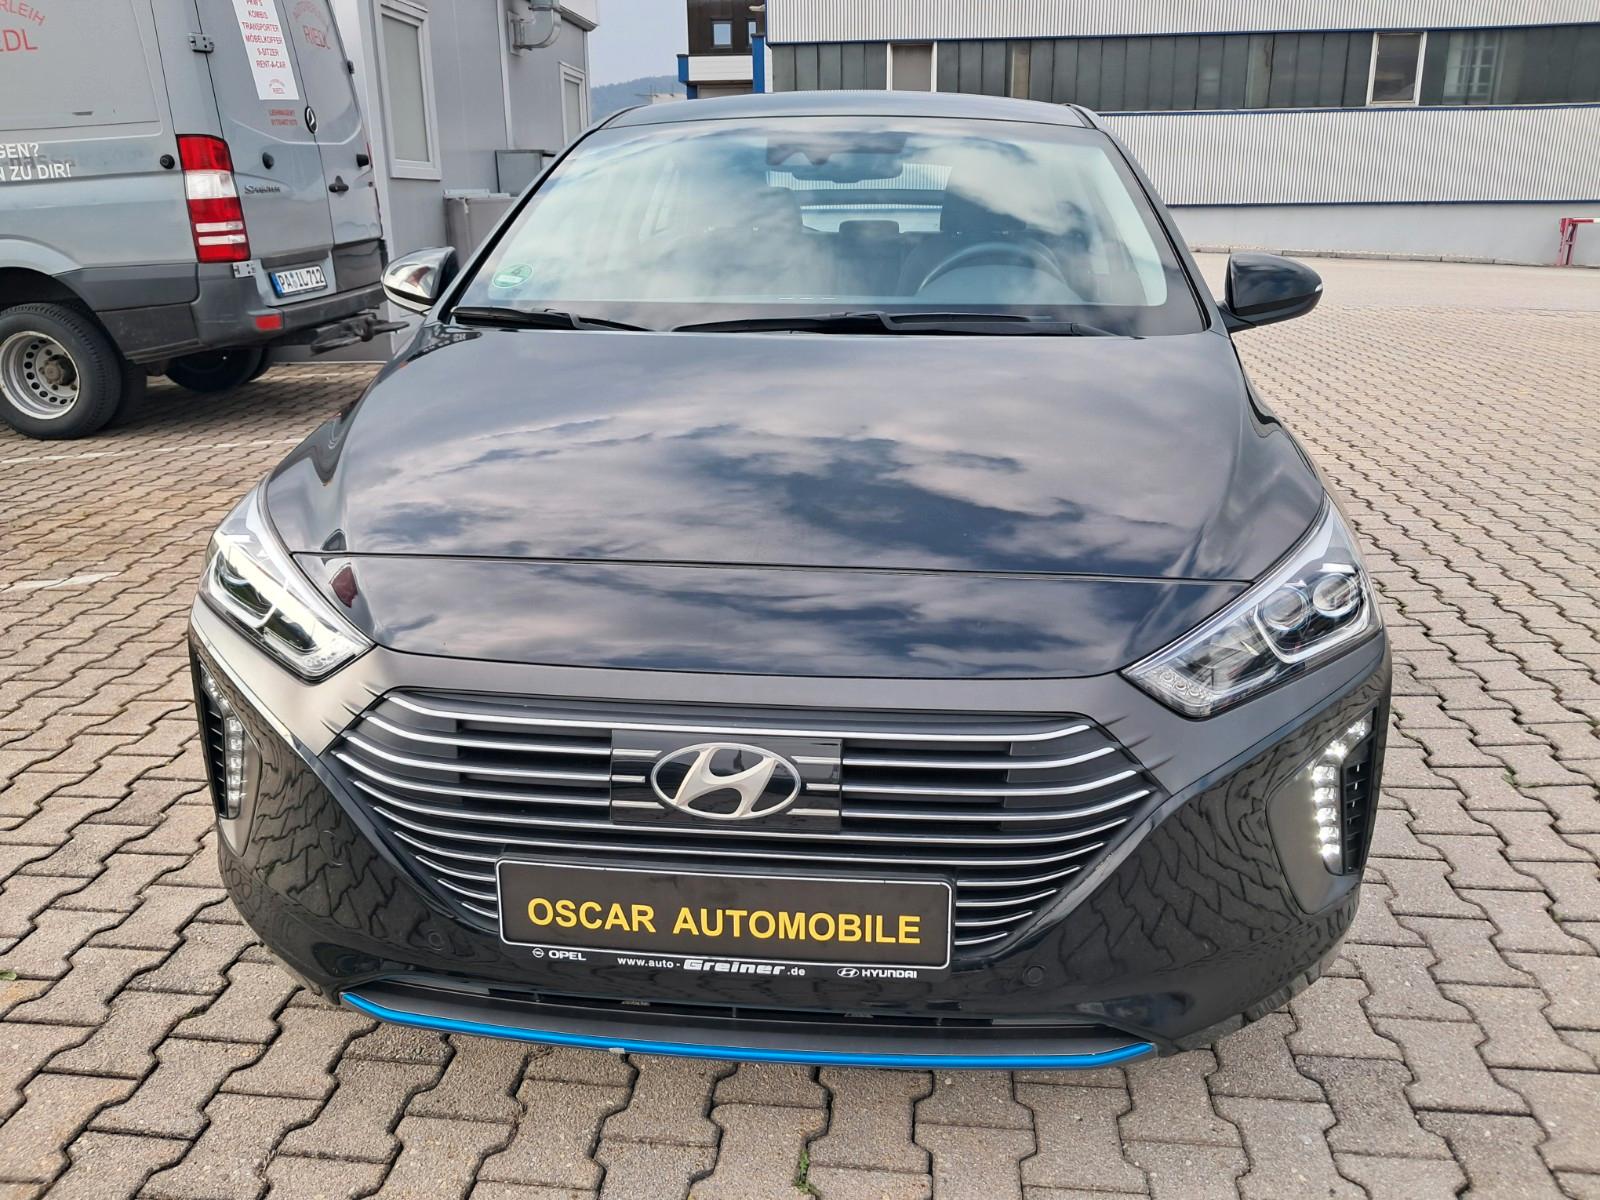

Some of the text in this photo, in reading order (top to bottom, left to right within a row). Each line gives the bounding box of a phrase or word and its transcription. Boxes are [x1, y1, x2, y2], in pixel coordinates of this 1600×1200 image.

[241, 21, 279, 32] TRANSPORTER
[245, 33, 282, 44] MÖBELKOFFER
[9, 165, 33, 181] ZU
[36, 163, 72, 179] DIR!
[277, 273, 292, 289] PA
[527, 897, 921, 944] OSCAR AUTOMOBILE
[548, 949, 587, 961] OPEL
[861, 968, 918, 979] HYUNDAI
